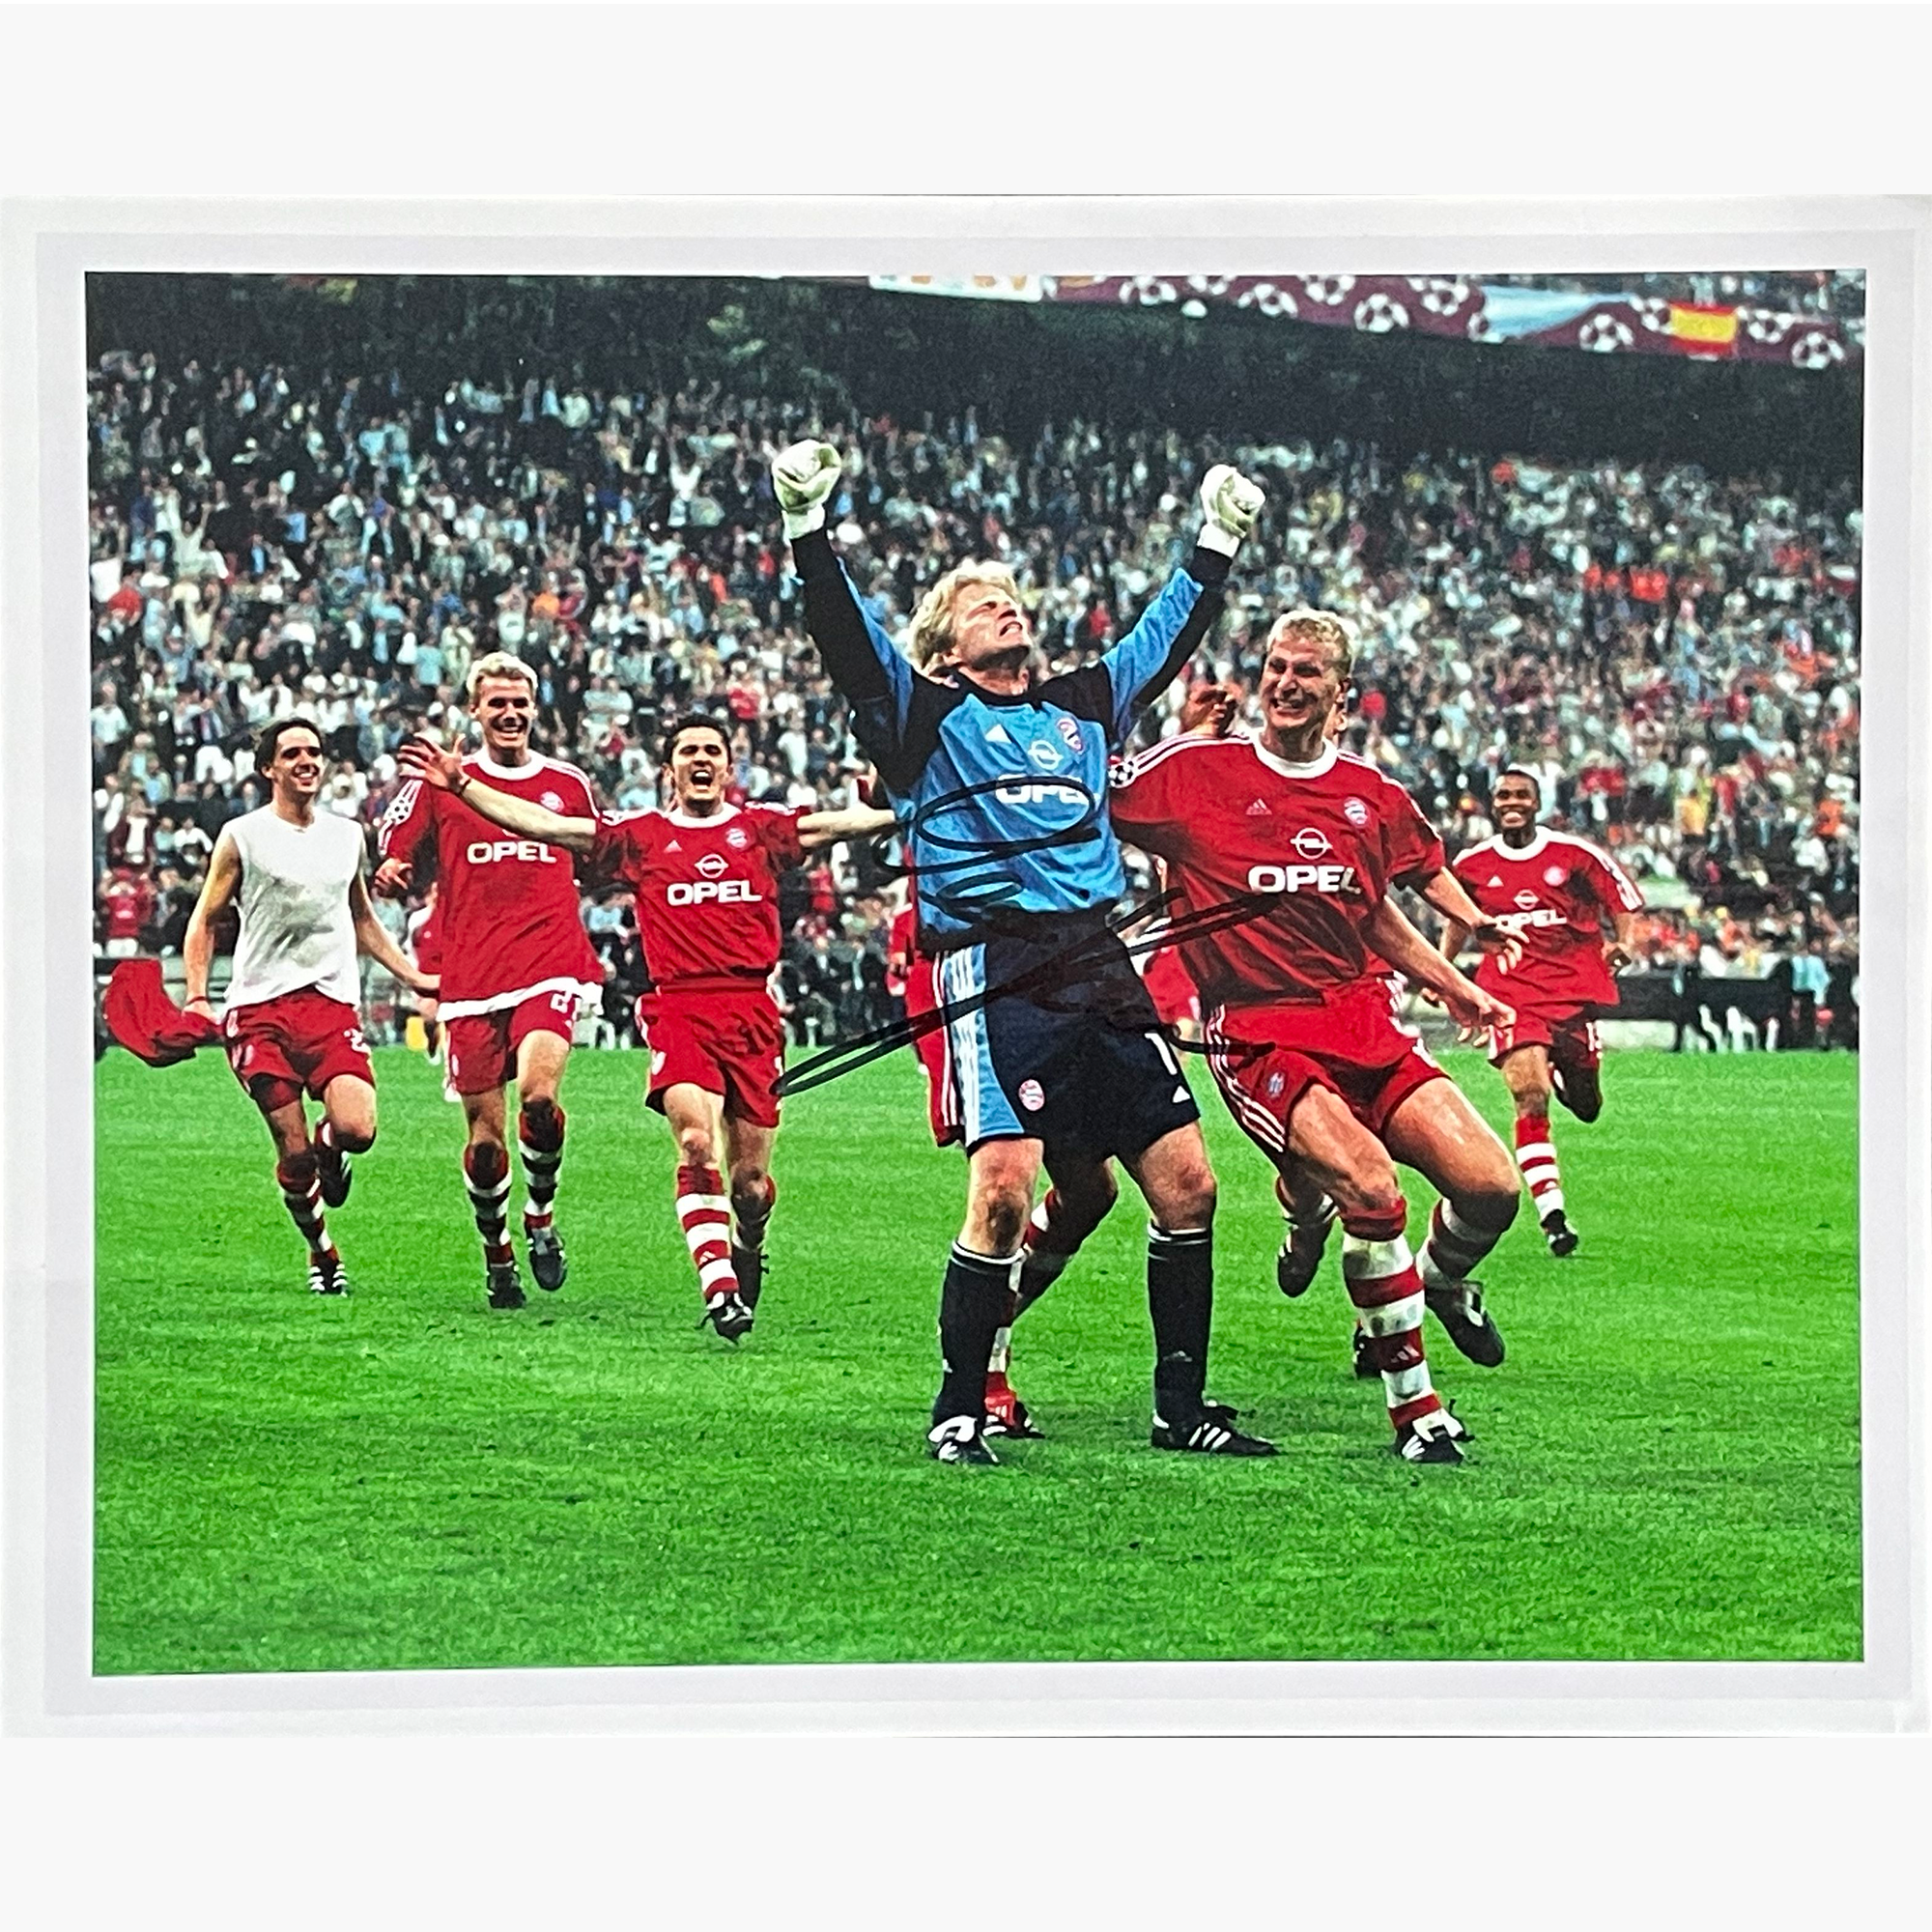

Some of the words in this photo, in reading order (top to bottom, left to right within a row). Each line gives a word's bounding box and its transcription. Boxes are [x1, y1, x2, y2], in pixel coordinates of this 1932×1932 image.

[468, 840, 557, 865] OPEL
[668, 879, 763, 906] OPEL
[1248, 866, 1361, 895] OPEL
[1144, 1033, 1178, 1075] 1
